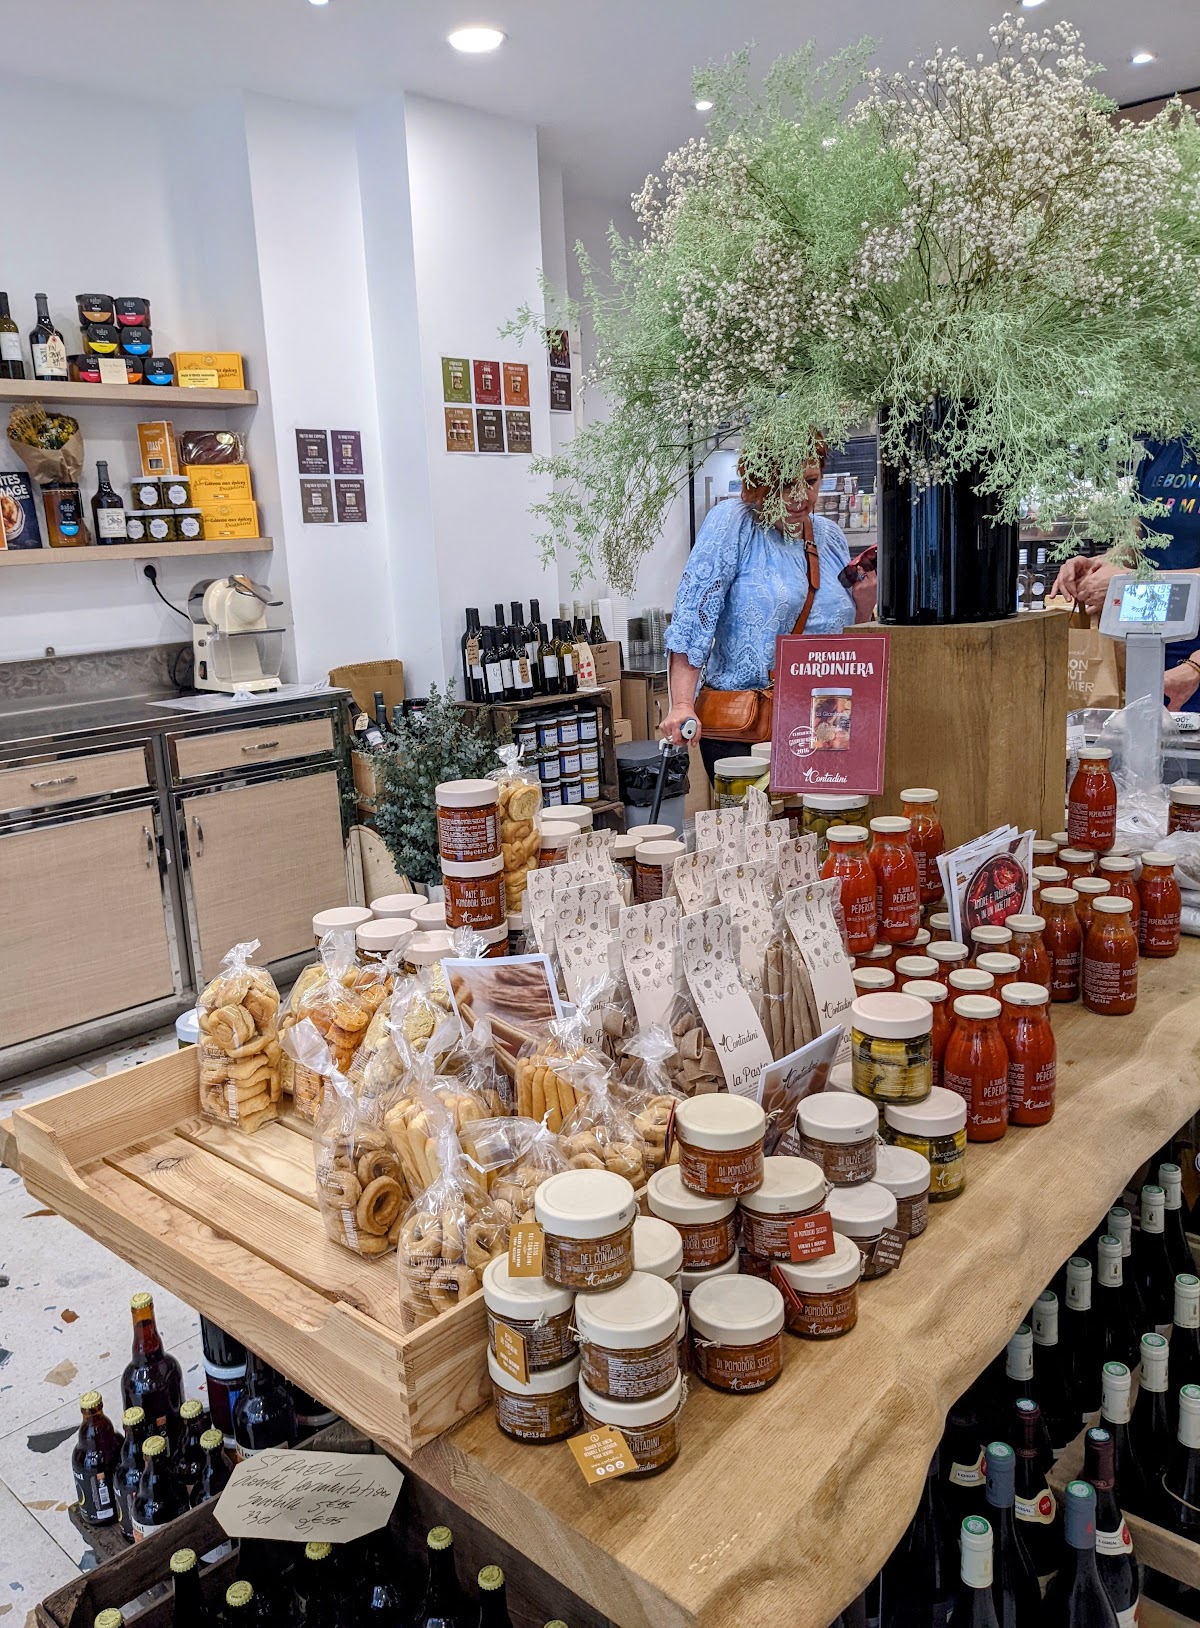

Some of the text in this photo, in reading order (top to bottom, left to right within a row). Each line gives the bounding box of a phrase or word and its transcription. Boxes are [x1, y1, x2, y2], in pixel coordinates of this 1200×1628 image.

[1152, 473, 1198, 489] LE BON
[807, 651, 857, 662] PREMIATA
[789, 662, 875, 677] GIARDINIERA
[1067, 659, 1089, 670] ON
[732, 1073, 743, 1087] la
[718, 1166, 726, 1177] DI
[580, 1245, 624, 1265] DEI CONTADINI
[804, 1306, 834, 1317] POMODORI
[716, 1358, 723, 1369] DI
[724, 1361, 756, 1372] POMODORI
[627, 1437, 660, 1453] ONTADINI
